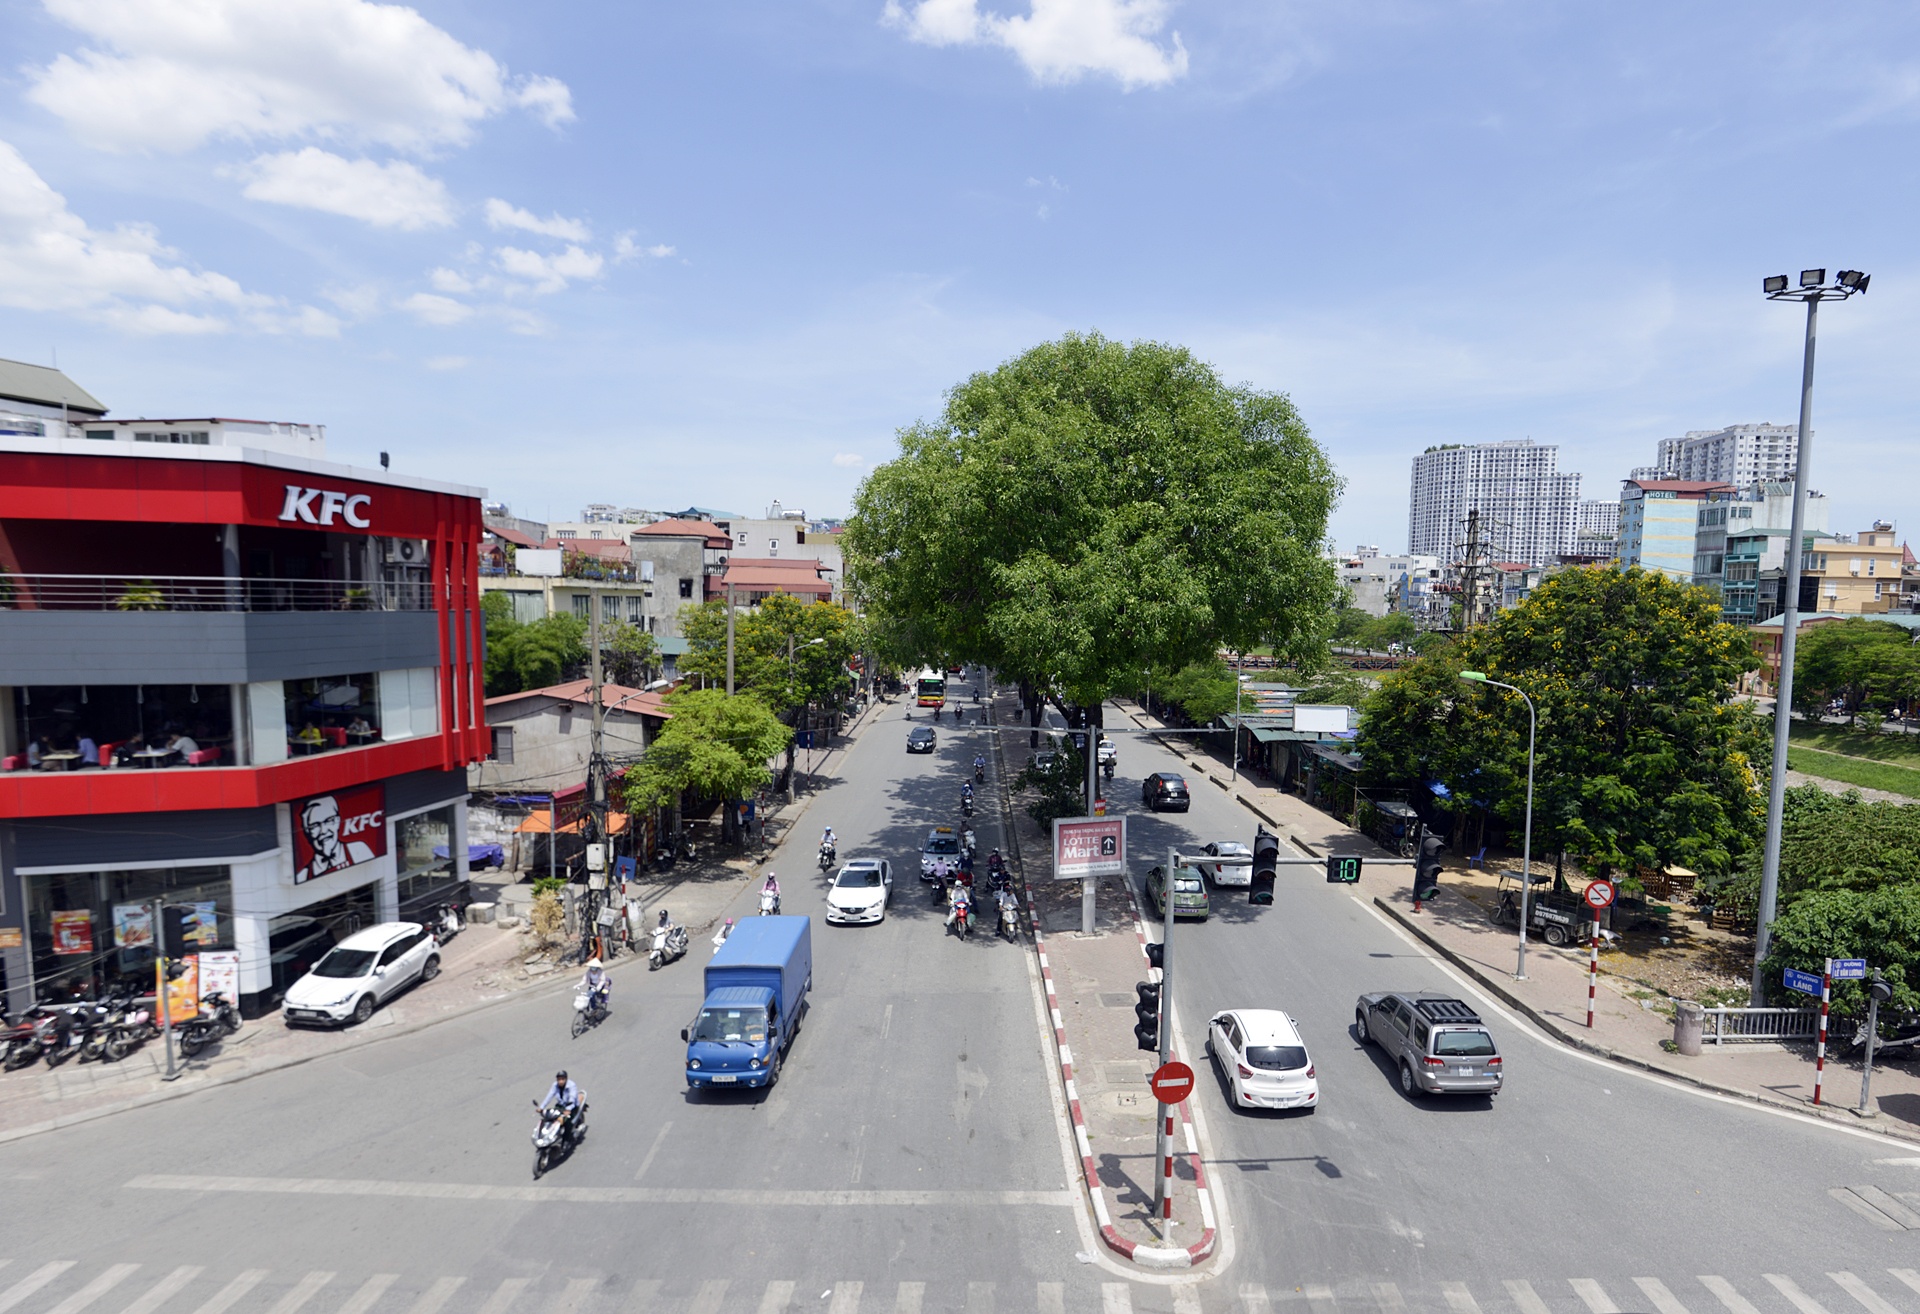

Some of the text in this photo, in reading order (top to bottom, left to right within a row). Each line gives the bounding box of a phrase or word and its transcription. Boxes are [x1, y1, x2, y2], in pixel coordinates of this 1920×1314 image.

[278, 484, 371, 528] KFC
[342, 810, 383, 836] KFC
[1063, 836, 1099, 846] LOTTE
[1063, 845, 1099, 859] Mart
[1340, 859, 1356, 880] 10
[1793, 979, 1812, 991] LÁNG
